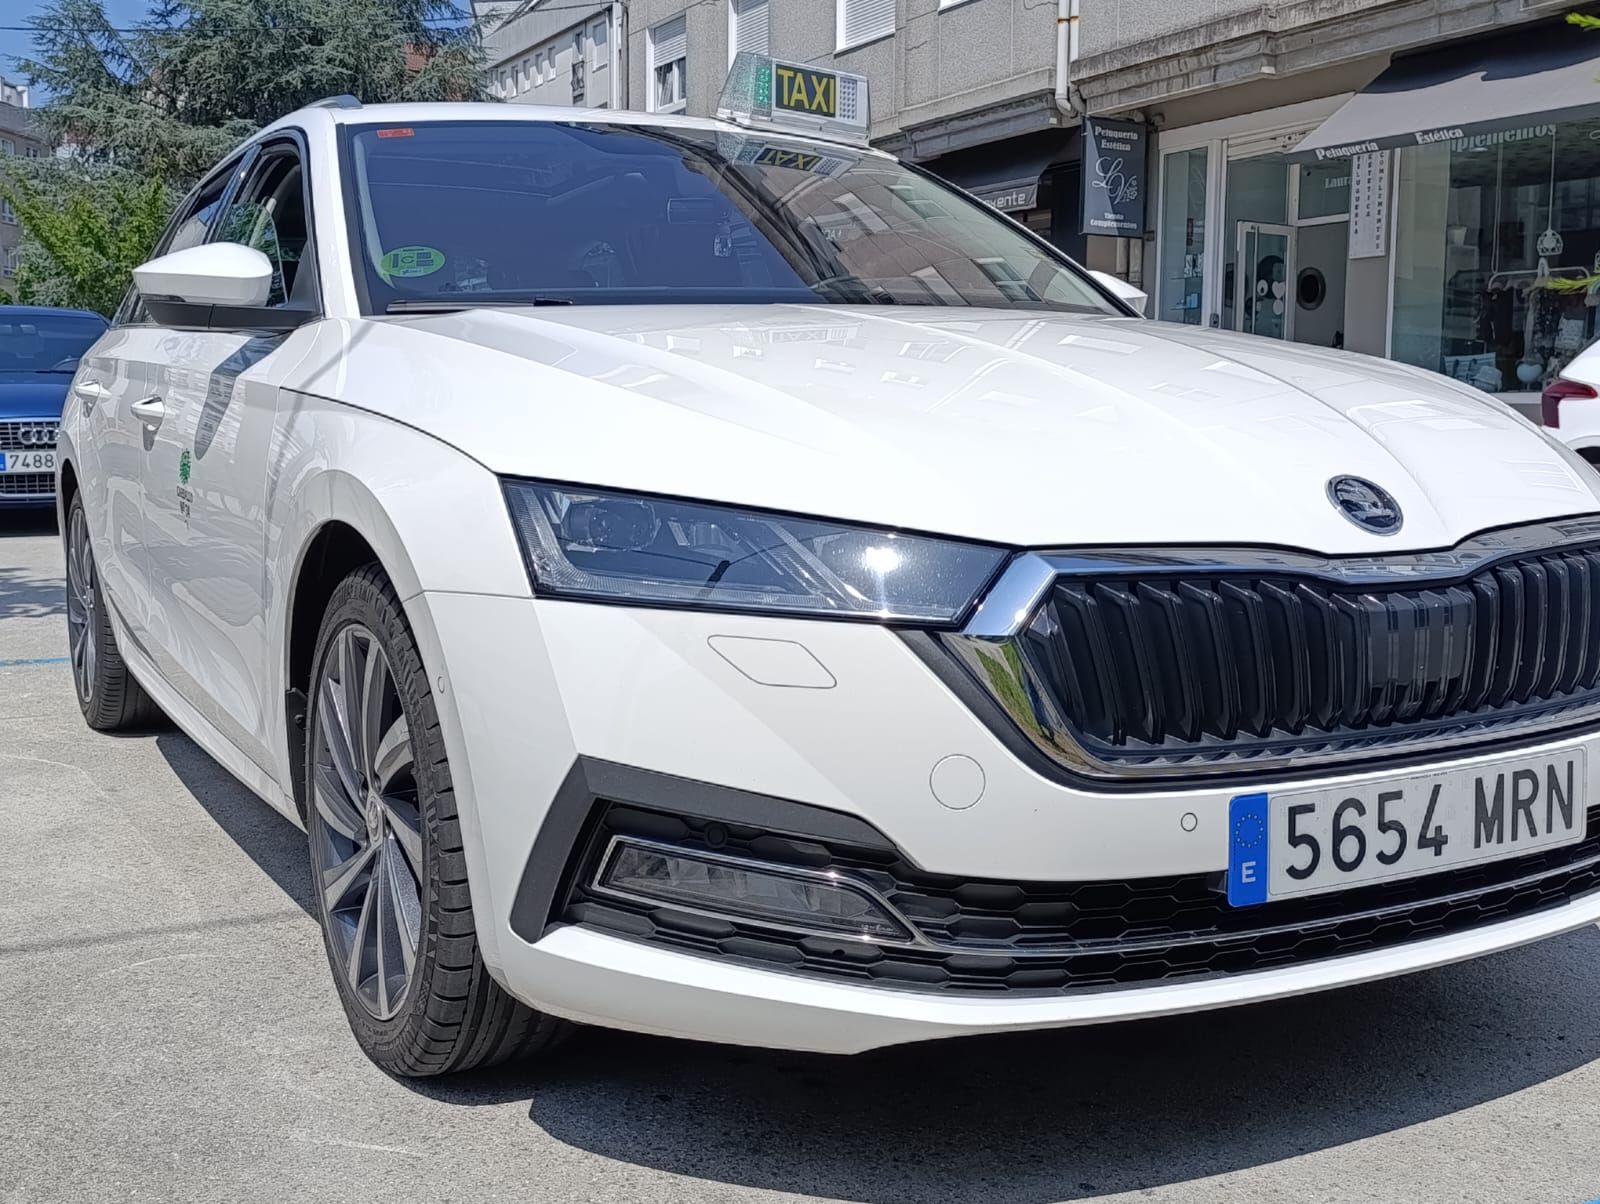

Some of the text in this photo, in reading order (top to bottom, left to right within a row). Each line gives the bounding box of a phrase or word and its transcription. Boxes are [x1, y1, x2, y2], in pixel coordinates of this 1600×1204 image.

[777, 68, 836, 114] TAXI
[1314, 127, 1465, 161] Peluquería Estética
[9, 454, 55, 469] 7488
[1285, 760, 1575, 881] 5654 MRN
[1241, 860, 1257, 884] E
